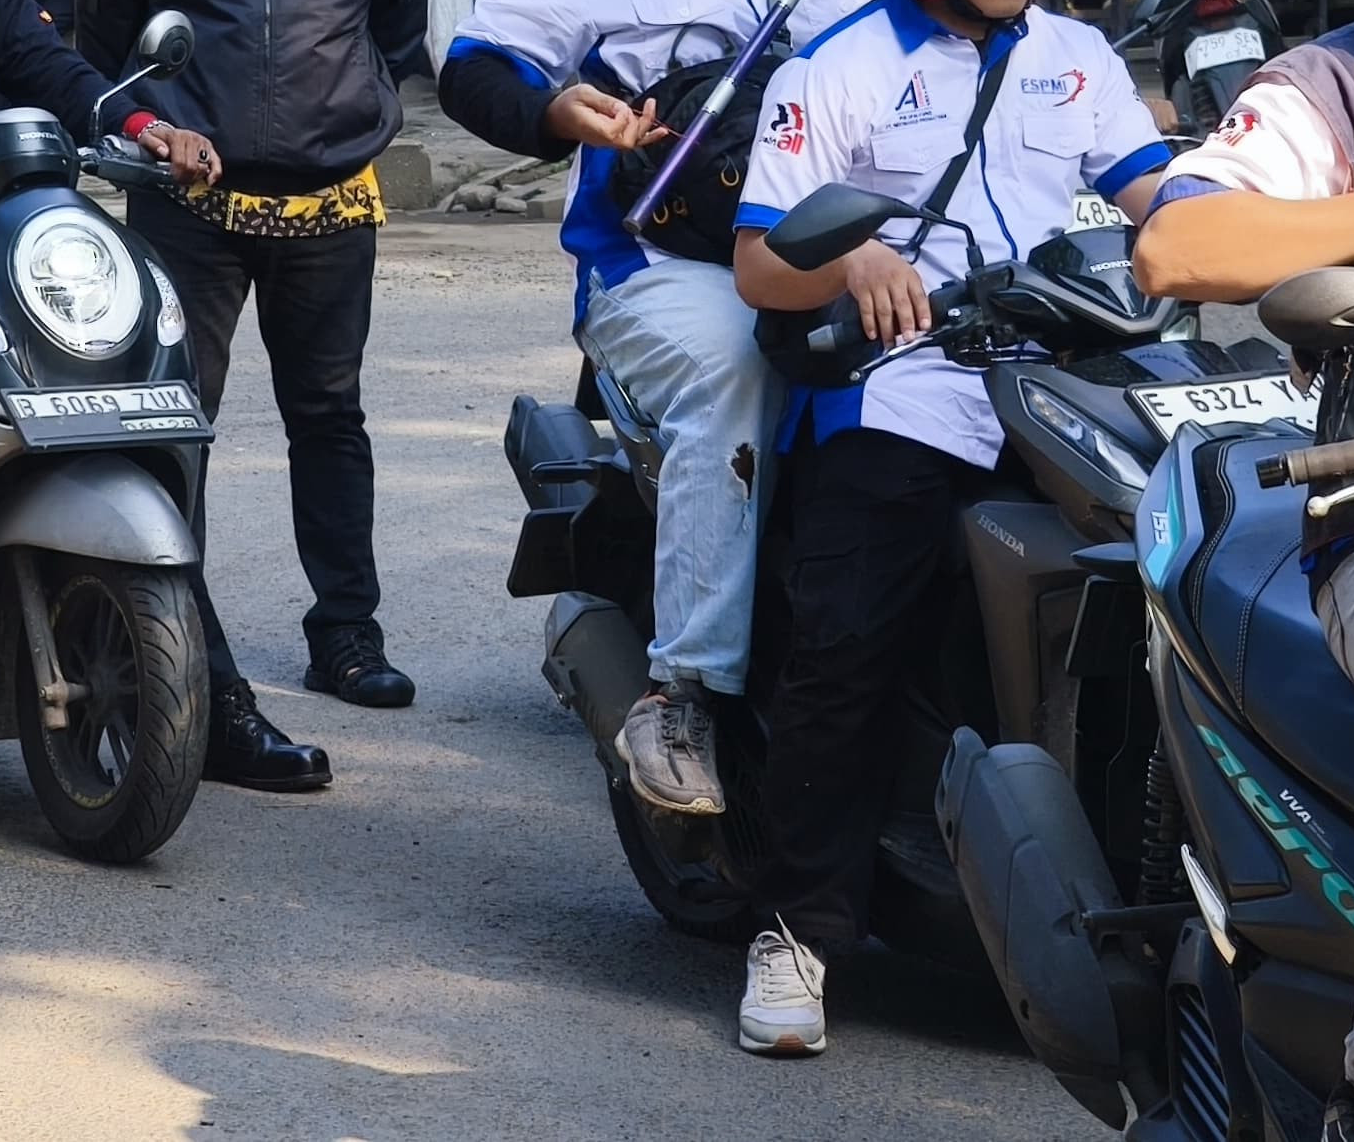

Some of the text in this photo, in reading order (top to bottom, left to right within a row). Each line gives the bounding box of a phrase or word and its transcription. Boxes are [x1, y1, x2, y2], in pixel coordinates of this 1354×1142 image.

[18, 130, 60, 142] HONDA
[1090, 260, 1134, 273] HOND
[50, 394, 121, 416] 6069
[1144, 392, 1173, 418] E
[1185, 384, 1263, 413] 6324
[977, 514, 1025, 558] HONDA
[1279, 789, 1312, 824] VVA
